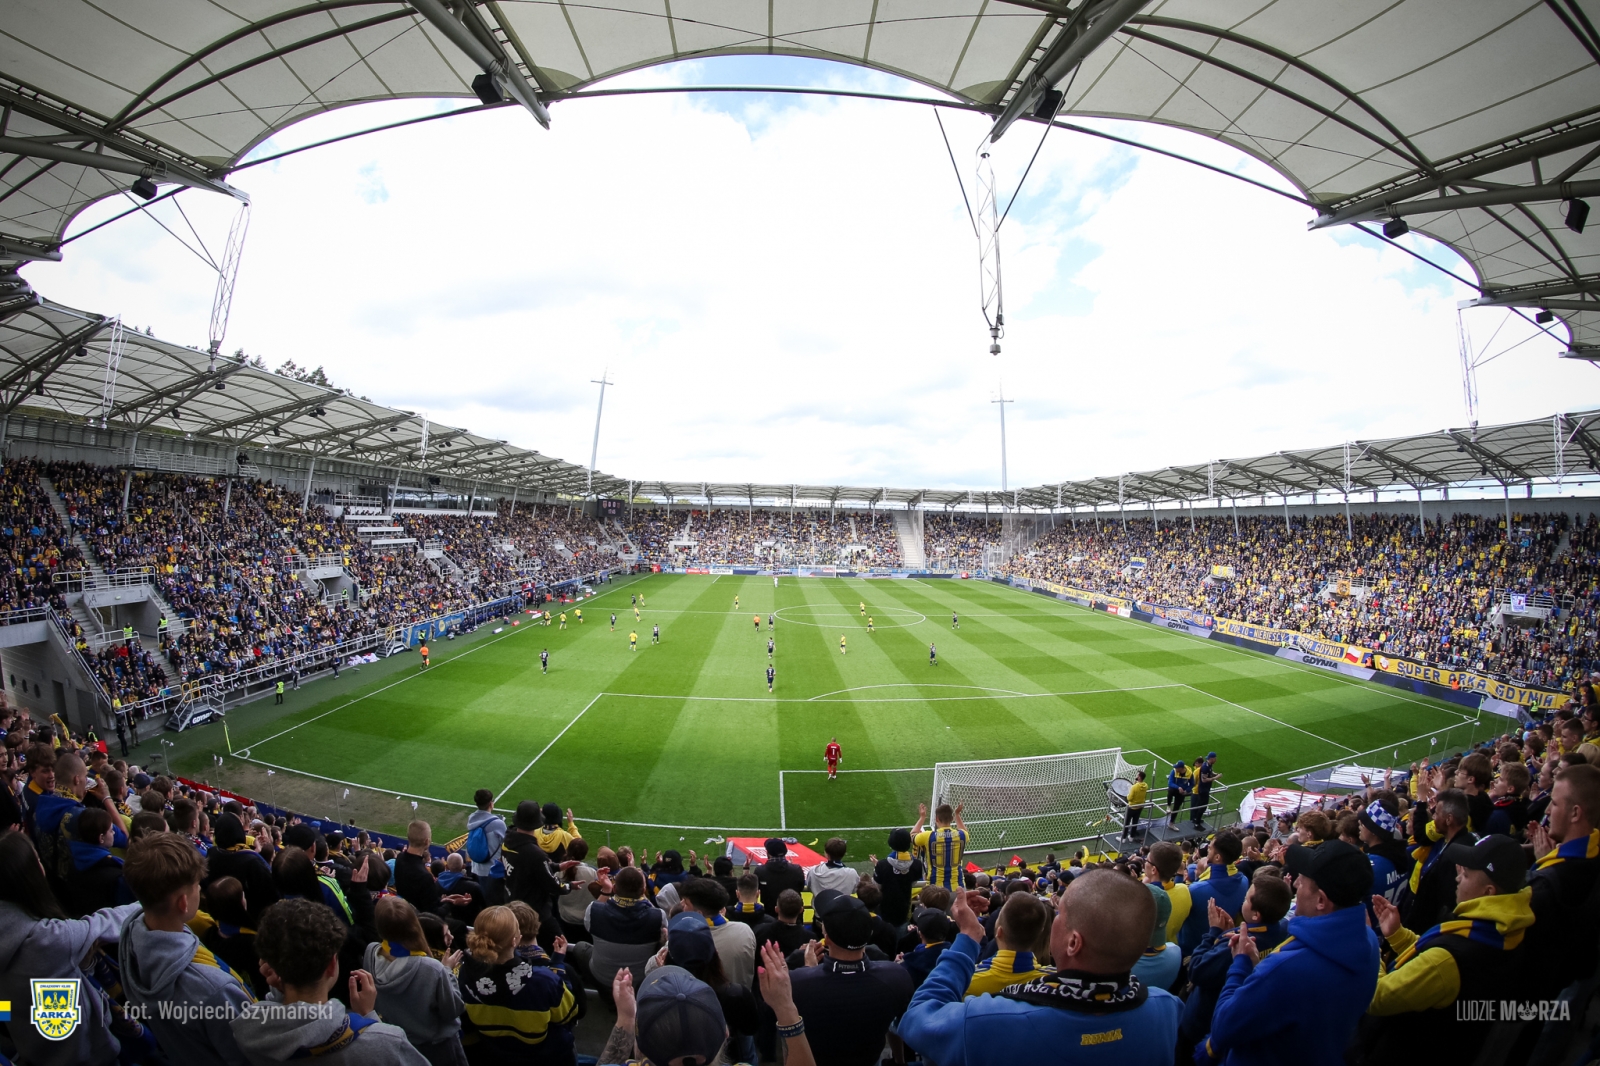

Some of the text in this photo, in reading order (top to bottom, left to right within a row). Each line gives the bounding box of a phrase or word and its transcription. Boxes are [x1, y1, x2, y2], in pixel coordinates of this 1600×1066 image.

[1168, 622, 1190, 631] GDYNIA
[1315, 644, 1341, 657] GDYNIA
[1302, 655, 1338, 669] GDYNIA
[1397, 661, 1554, 707] SUPER ARKA GDYNIA
[931, 840, 964, 867] 90
